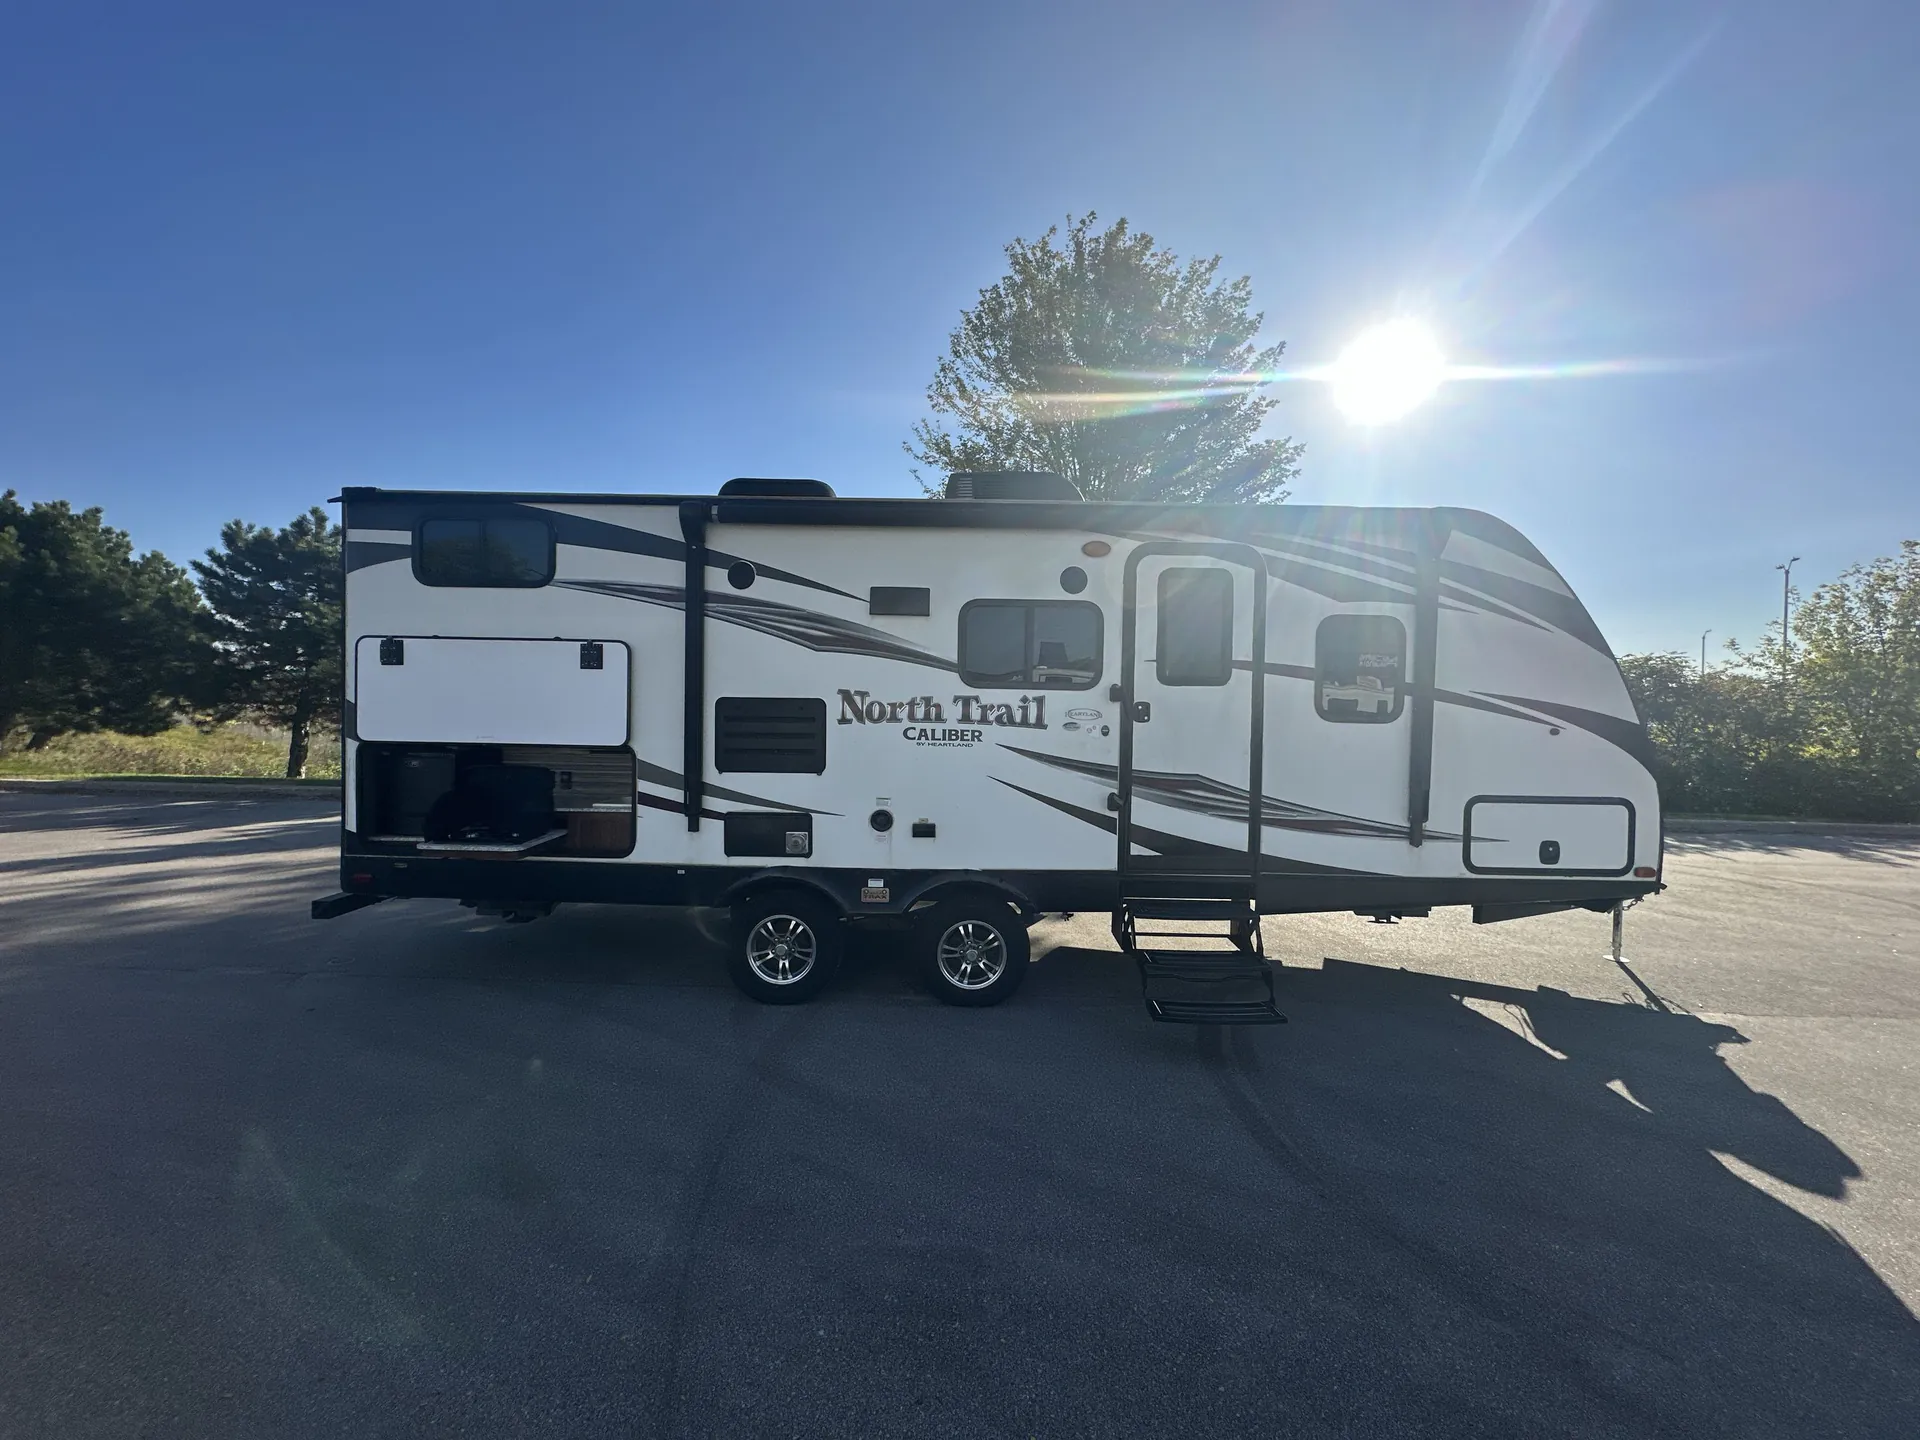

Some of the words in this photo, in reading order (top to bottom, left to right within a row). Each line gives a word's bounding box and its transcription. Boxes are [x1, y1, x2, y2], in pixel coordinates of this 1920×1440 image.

[837, 688, 947, 725] North
[952, 694, 1048, 730] Trail
[902, 726, 983, 742] CALIBER
